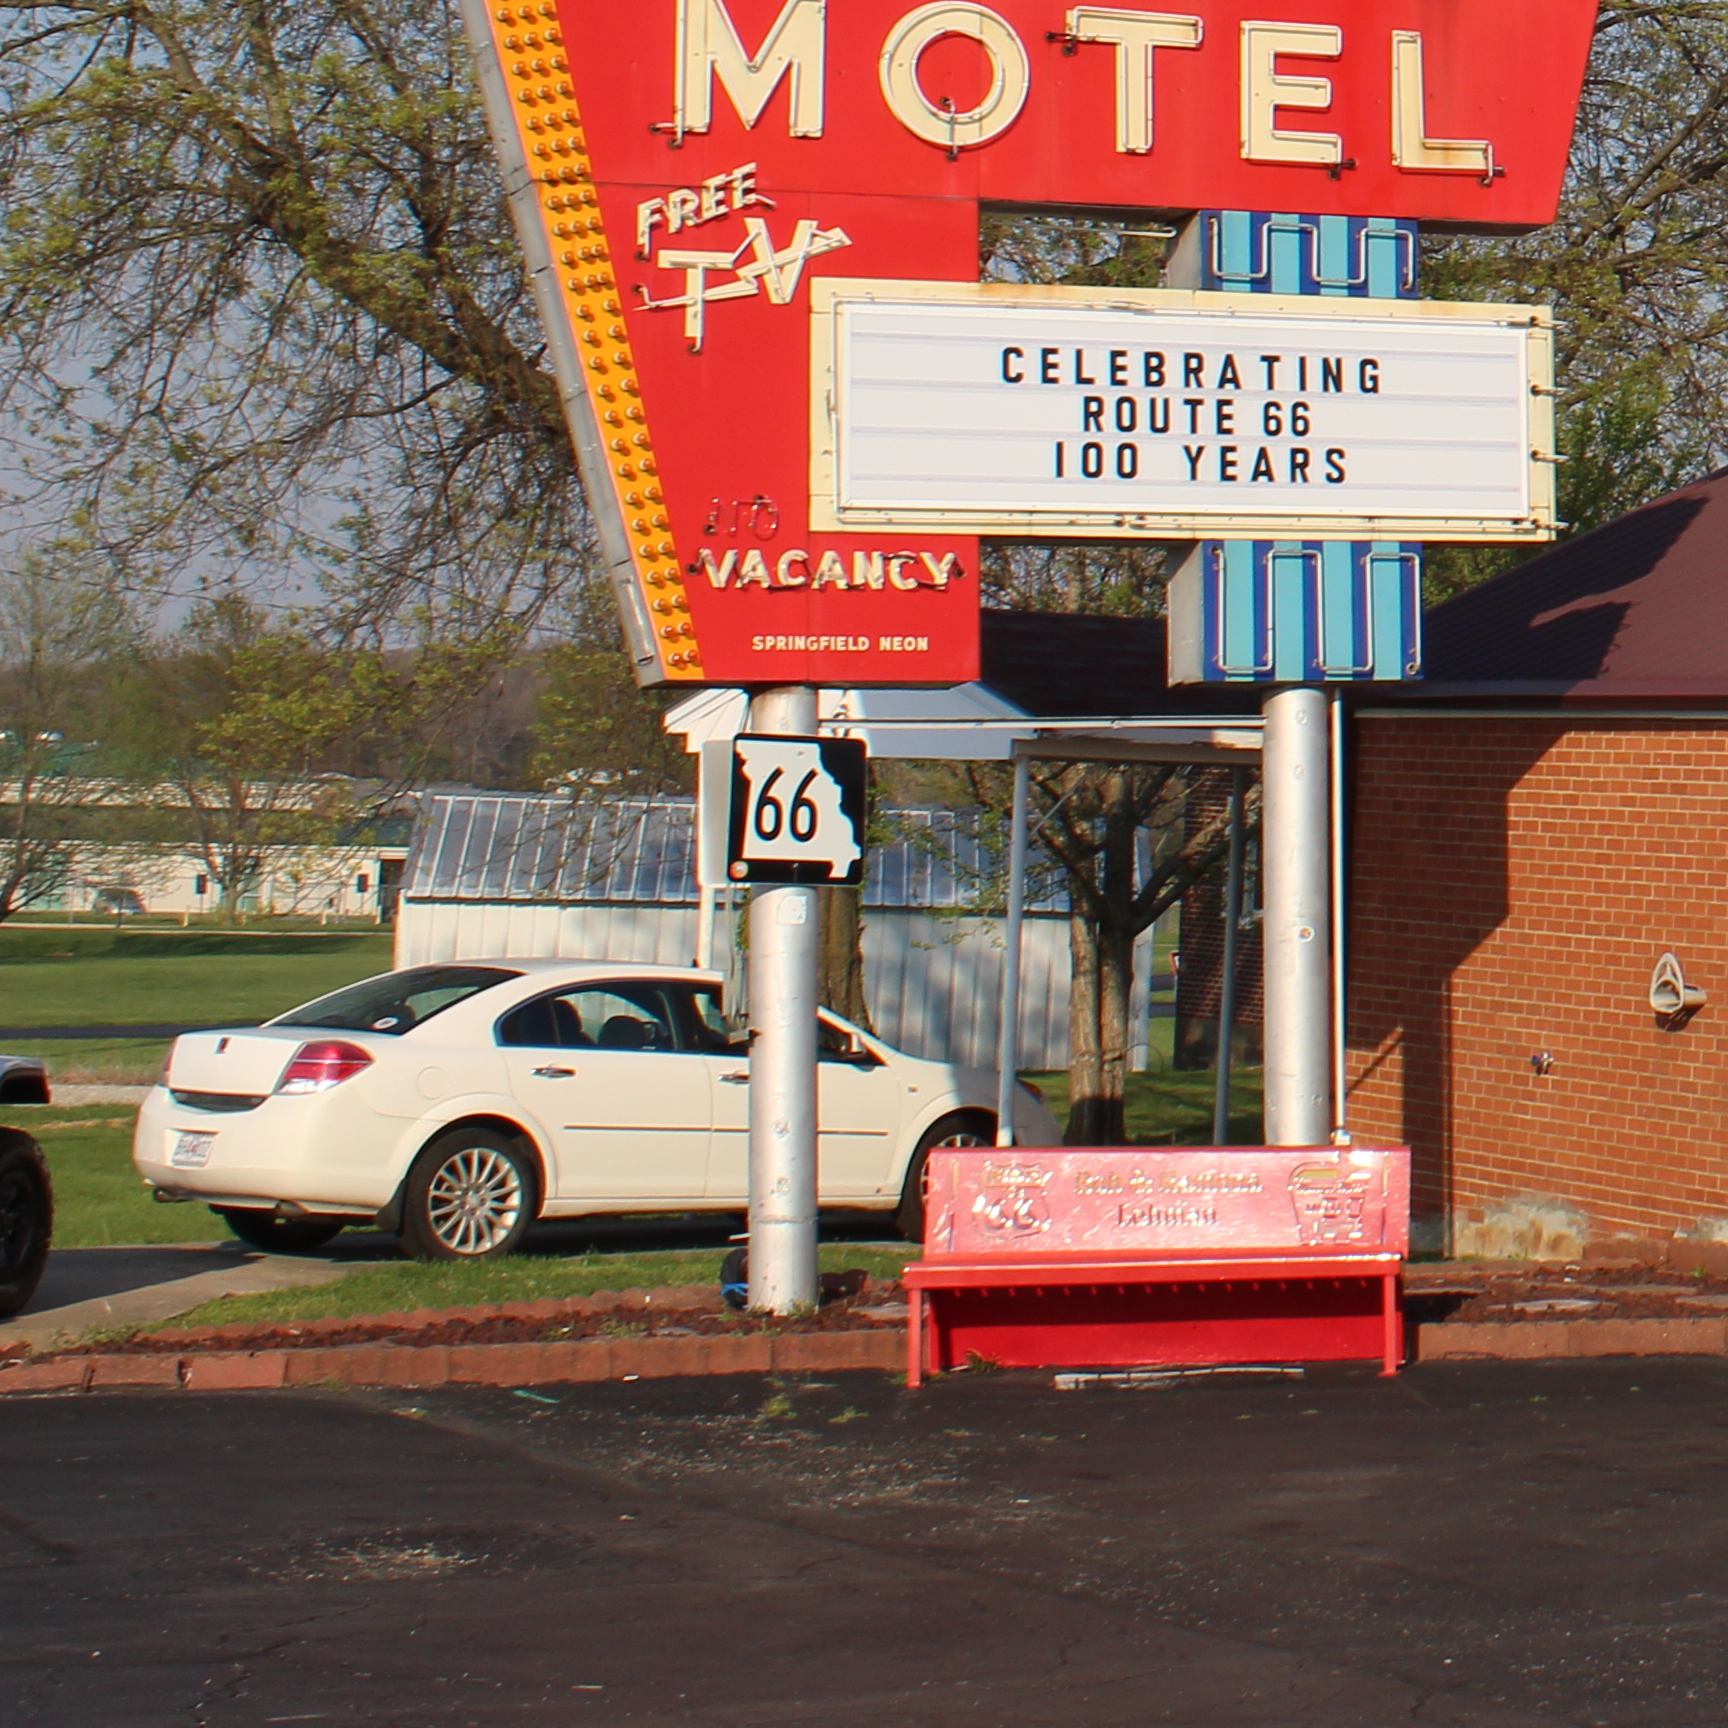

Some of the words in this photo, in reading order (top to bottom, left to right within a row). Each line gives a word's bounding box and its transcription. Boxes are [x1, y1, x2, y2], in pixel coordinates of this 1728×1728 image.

[637, 162, 758, 245] FREE
[655, 217, 825, 338] TV
[1002, 347, 1382, 394] CELEBRATING
[1084, 397, 1234, 437] ROUTE
[1262, 400, 1311, 437] 66
[1055, 442, 1139, 480] 100
[1183, 445, 1349, 485] YEARS
[708, 496, 779, 540] NO
[700, 548, 955, 590] VACANCY
[752, 635, 870, 651] SPRINGFIELD
[879, 635, 928, 651] NEON
[753, 767, 820, 842] 66
